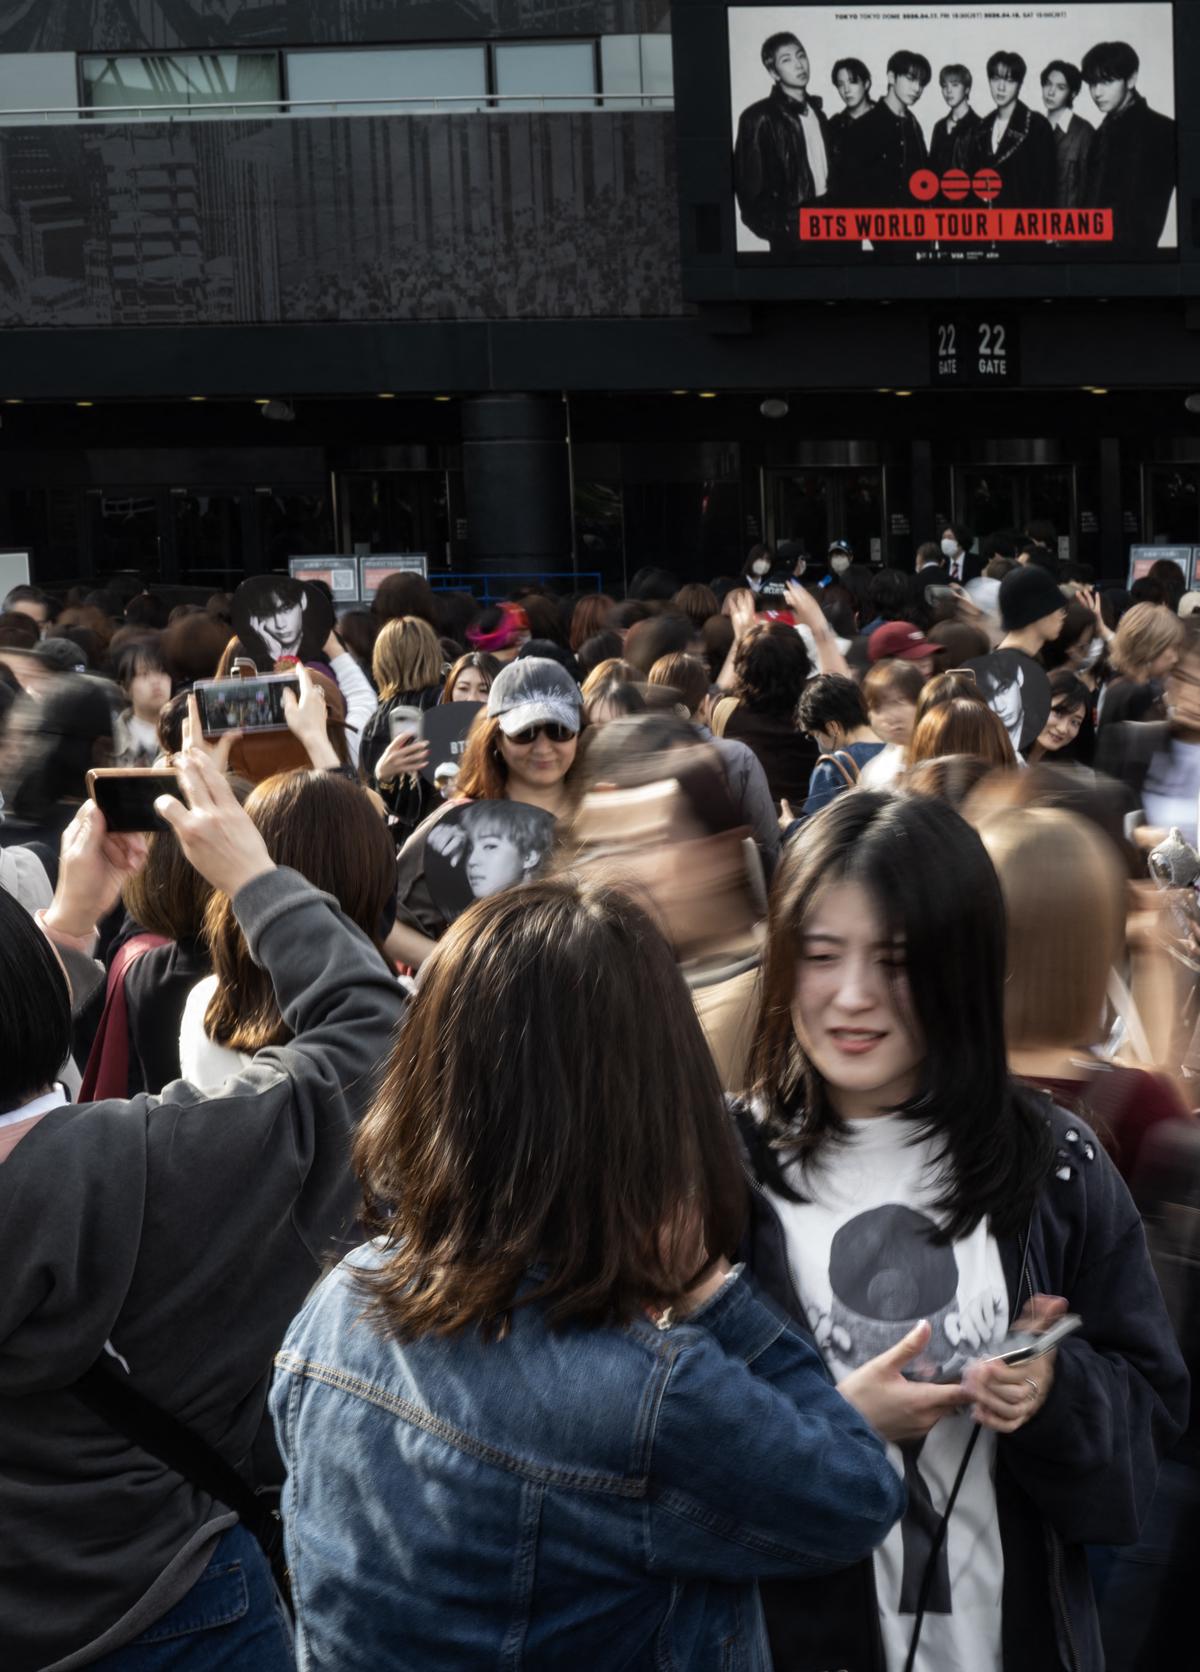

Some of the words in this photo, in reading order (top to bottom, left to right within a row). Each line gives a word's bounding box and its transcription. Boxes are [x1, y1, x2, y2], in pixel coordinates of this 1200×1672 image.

[809, 214, 847, 238] BTS
[855, 214, 925, 238] WORLD
[935, 213, 988, 237] TOUR
[1014, 212, 1105, 236] ARIRANG
[938, 323, 956, 356] 22
[978, 323, 1006, 356] 22
[938, 359, 957, 375] GATE
[978, 358, 1007, 375] GATE
[450, 740, 468, 755] BT
